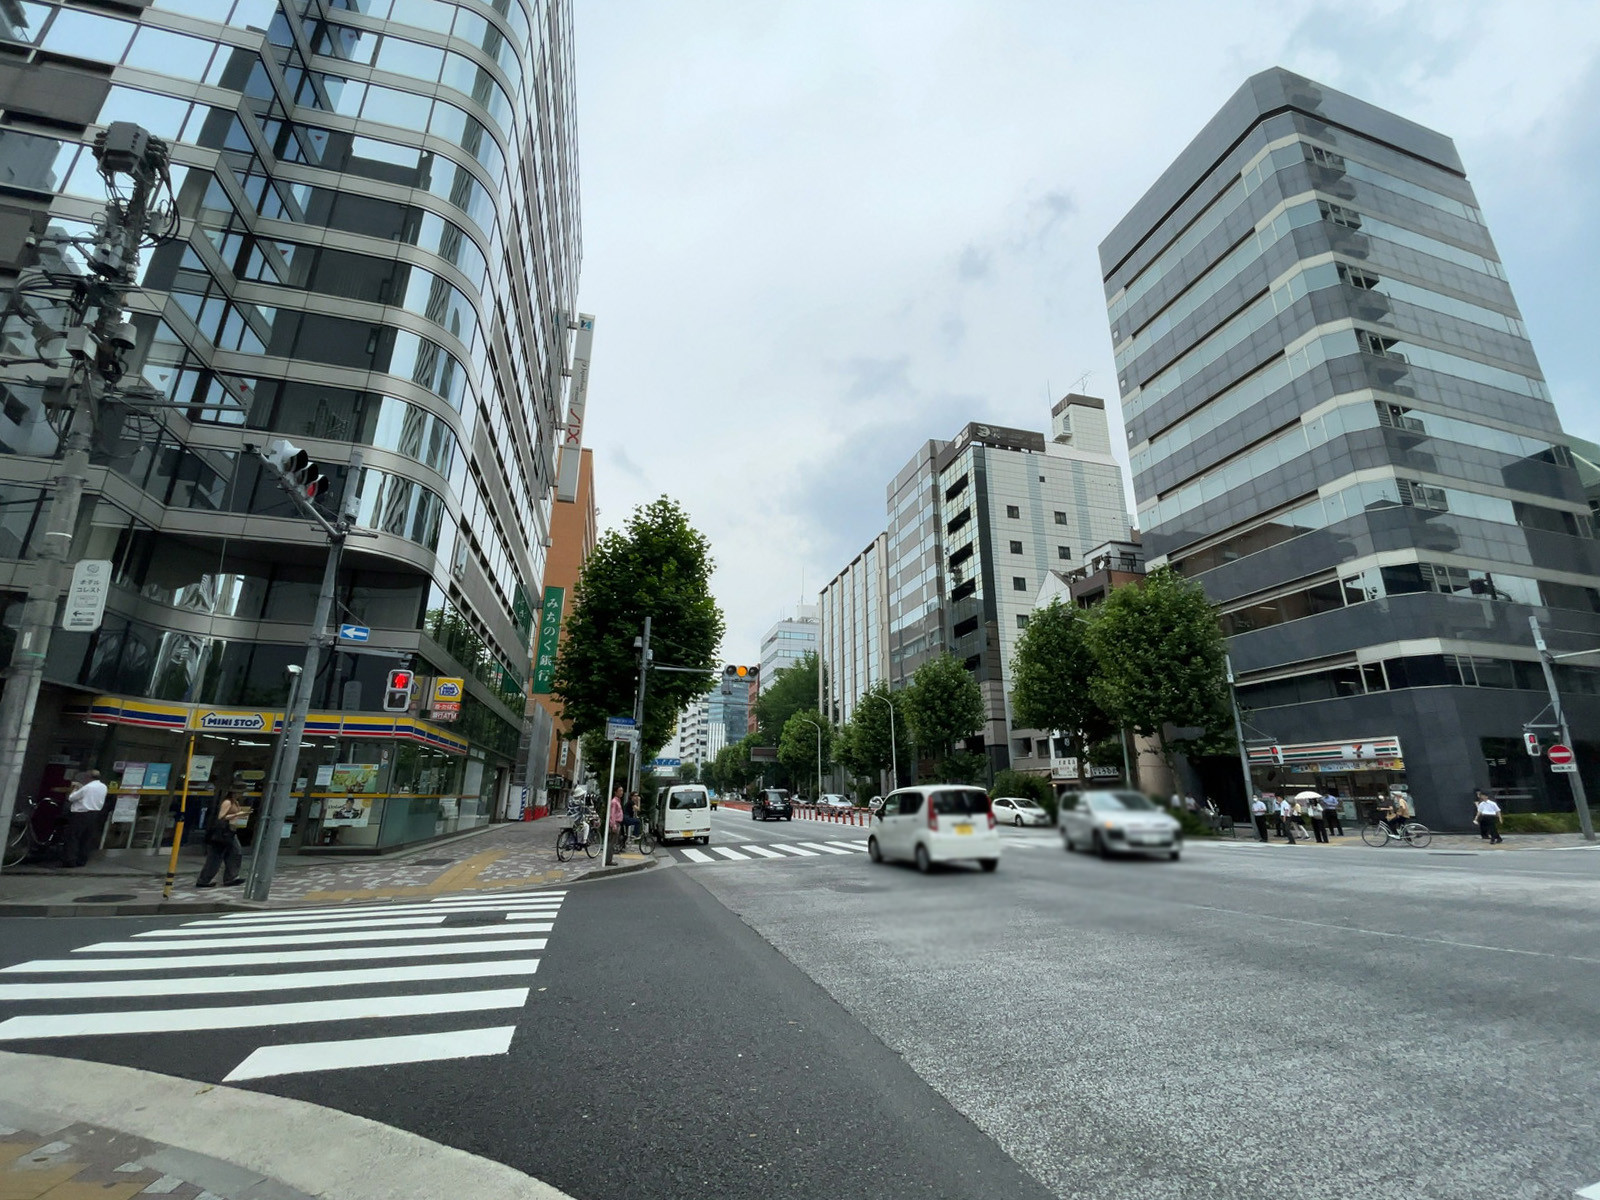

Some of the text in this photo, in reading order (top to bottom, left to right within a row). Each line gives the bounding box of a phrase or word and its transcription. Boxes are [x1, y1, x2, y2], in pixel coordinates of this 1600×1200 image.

[538, 598, 558, 682] みちのく銀行
[207, 717, 260, 727] MINI STOP
